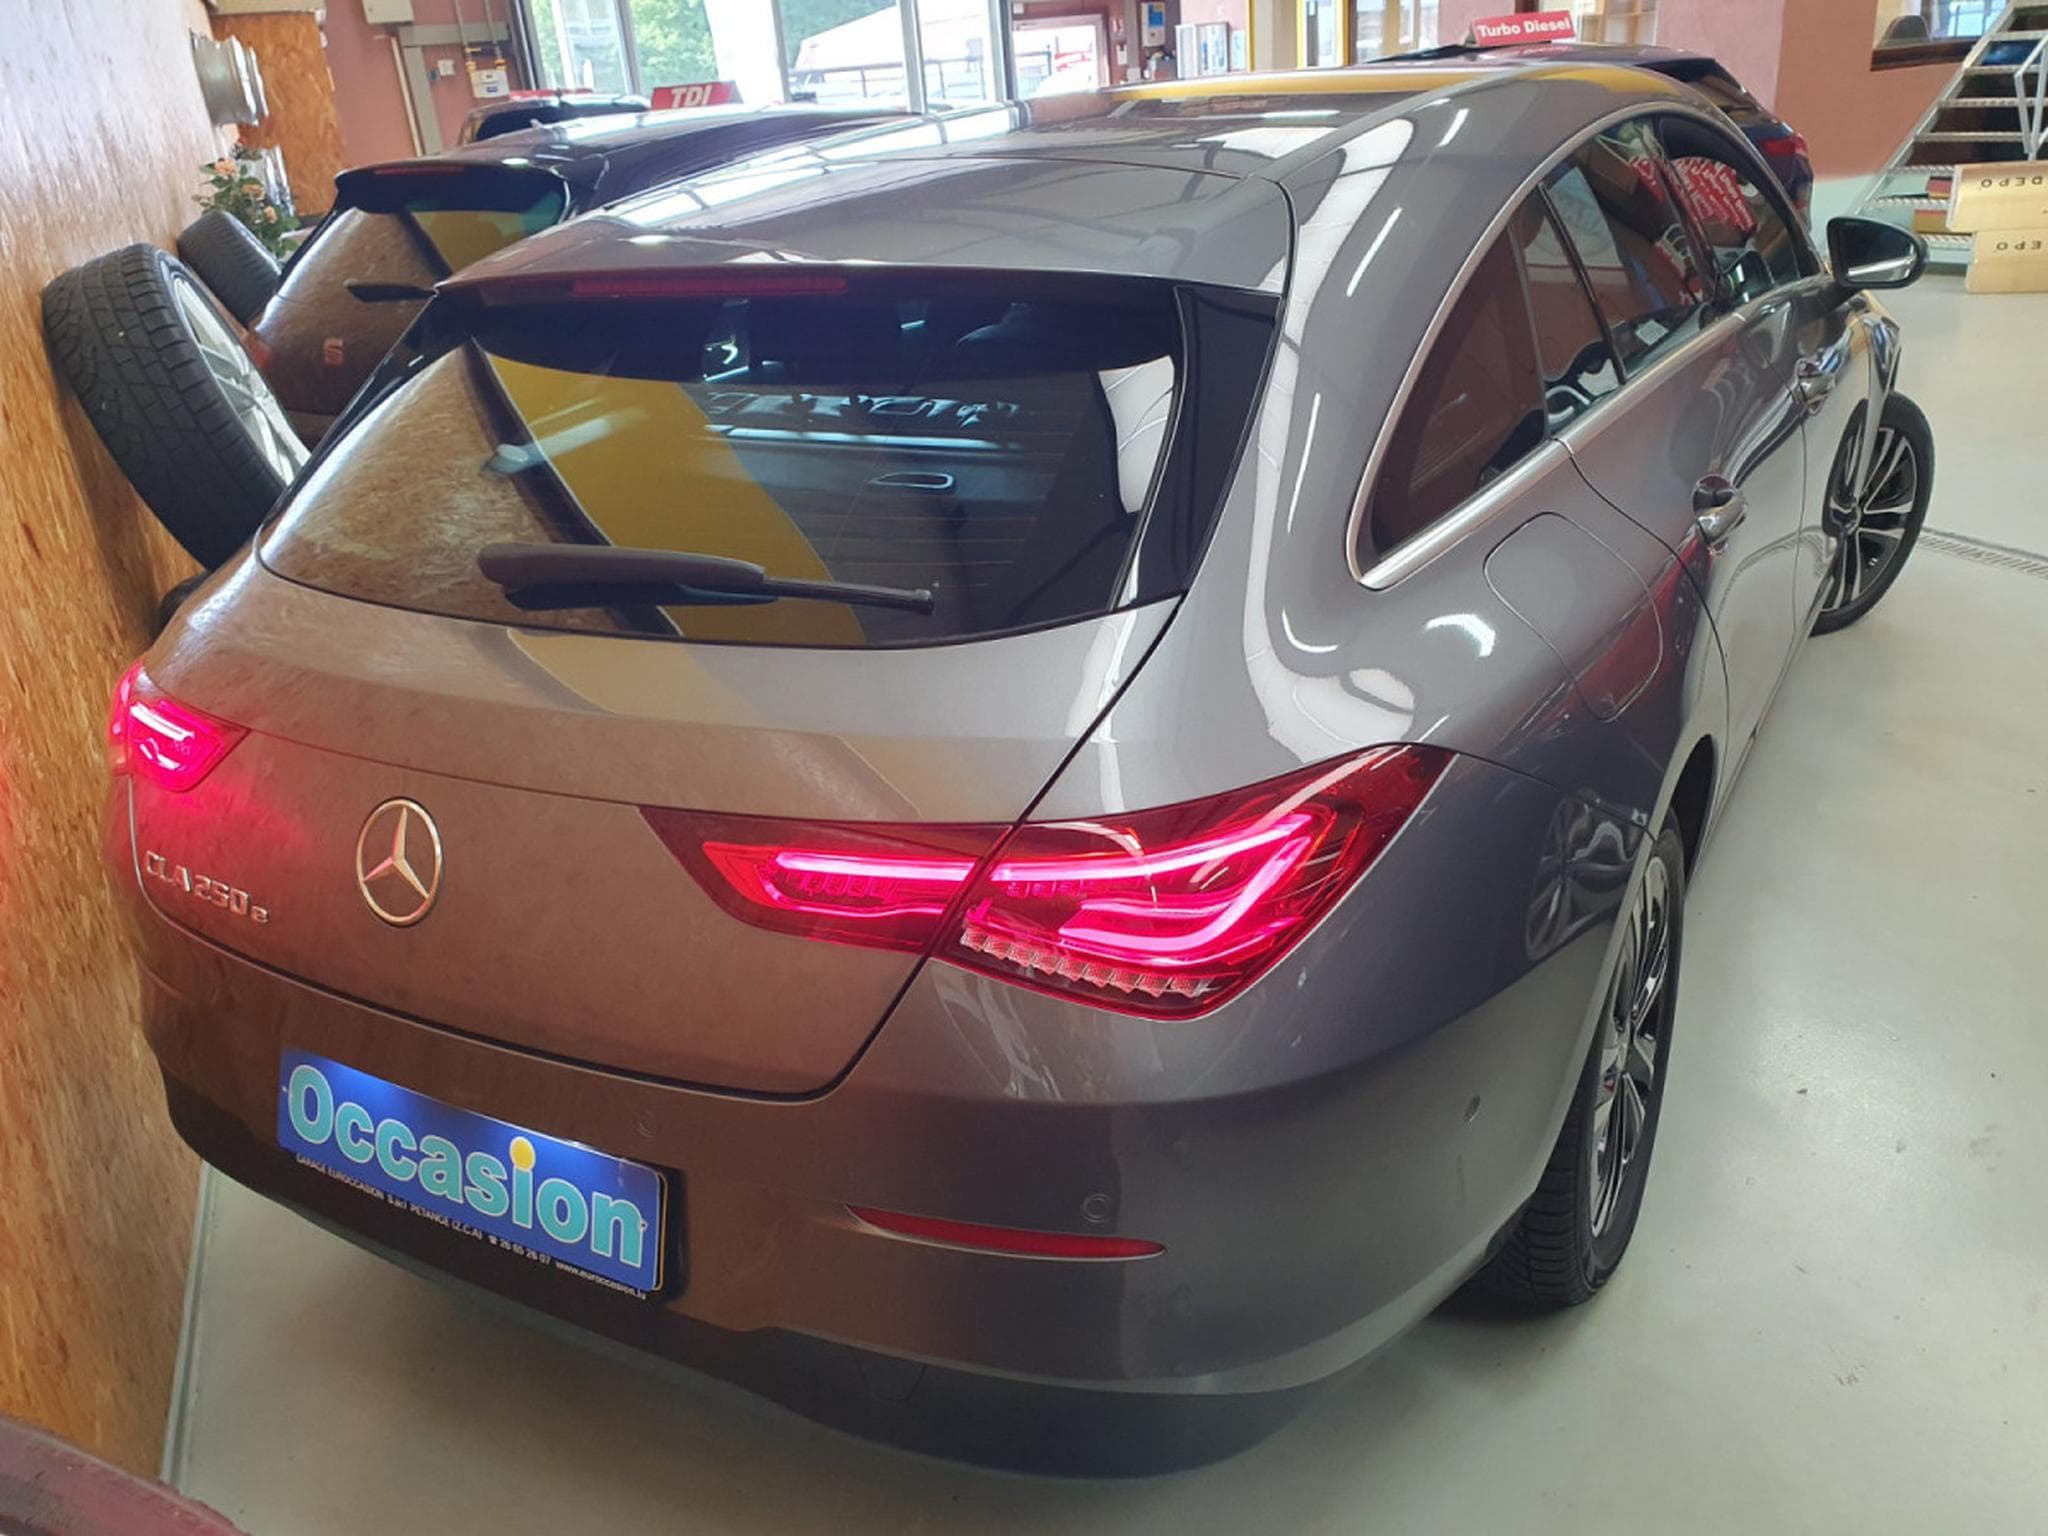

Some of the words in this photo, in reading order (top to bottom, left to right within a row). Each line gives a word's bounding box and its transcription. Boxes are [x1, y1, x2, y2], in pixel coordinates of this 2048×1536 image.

[1477, 22, 1521, 37] Turbo
[1523, 17, 1571, 33] Diesel
[671, 84, 713, 109] TDI
[1981, 175, 2043, 188] DEPO
[146, 850, 191, 893] CLA
[194, 874, 249, 916] 250
[287, 1064, 643, 1269] Occasion
